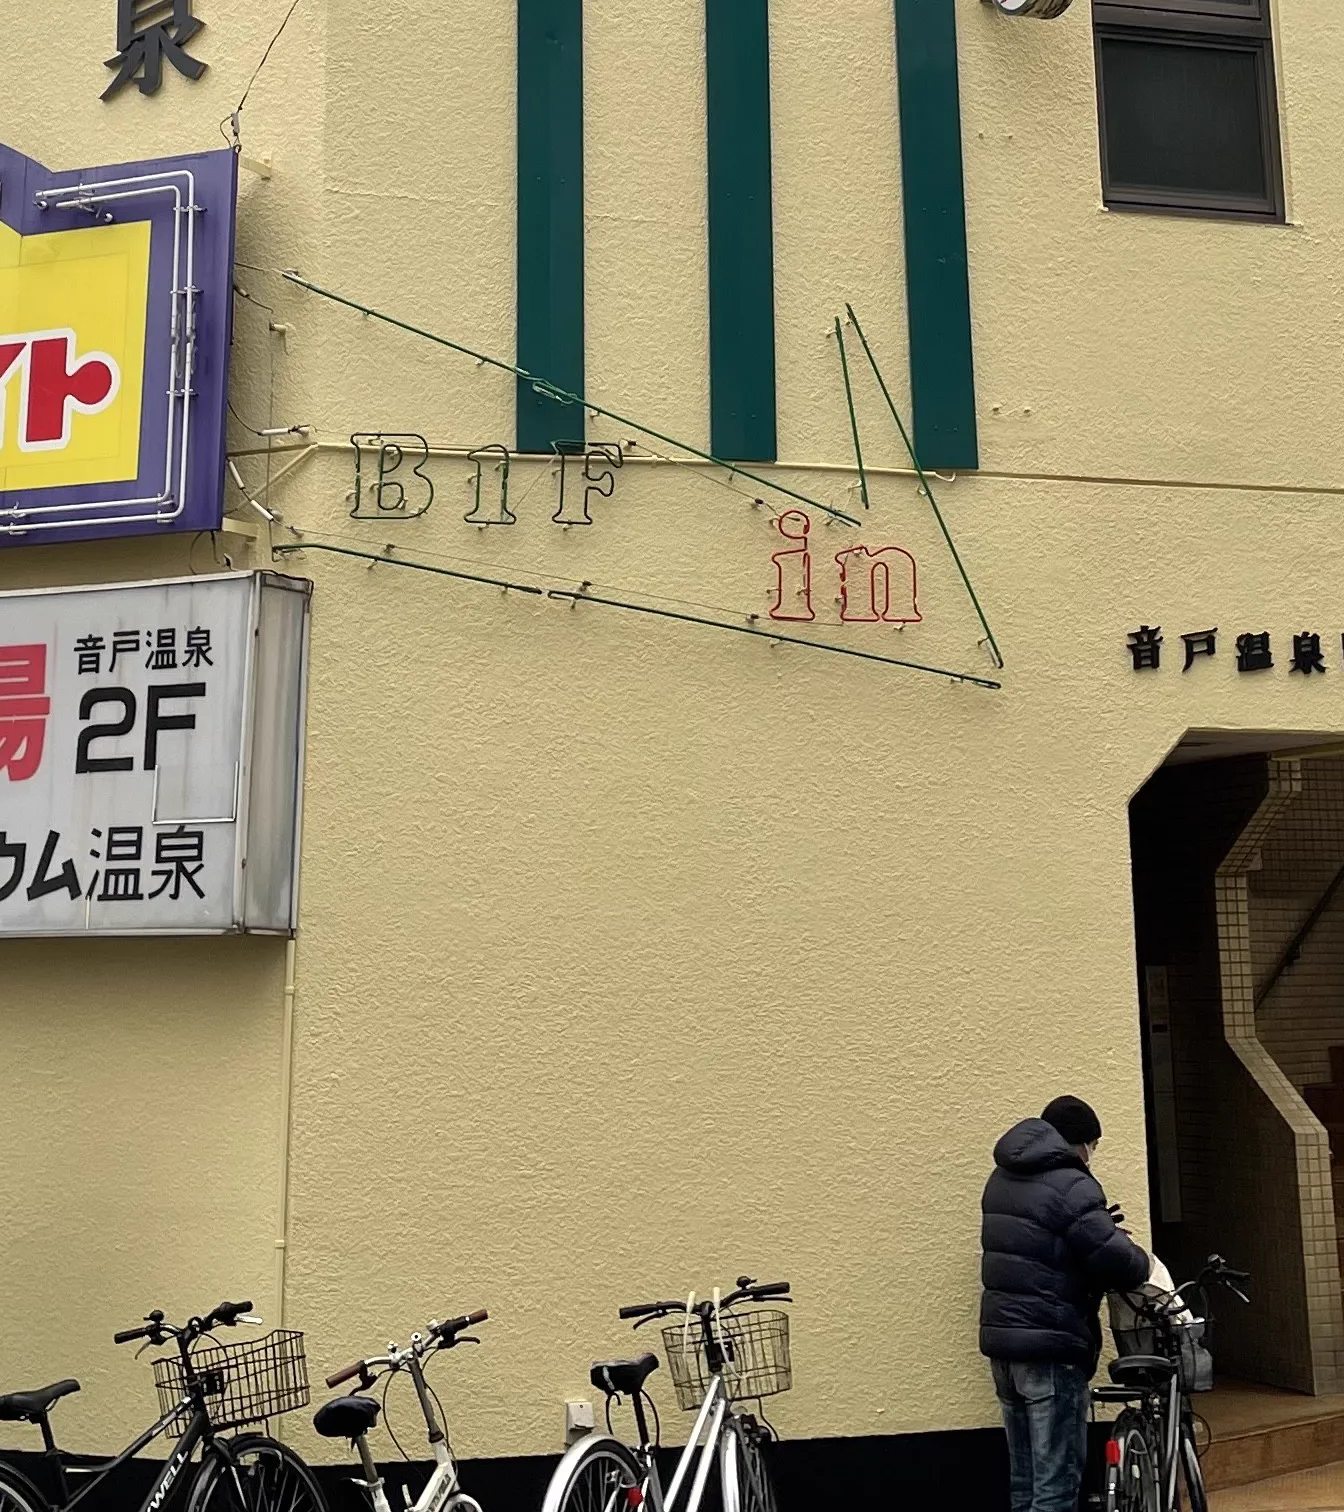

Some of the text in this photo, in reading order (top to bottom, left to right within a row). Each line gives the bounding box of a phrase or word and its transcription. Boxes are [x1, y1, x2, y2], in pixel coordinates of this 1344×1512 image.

[769, 510, 923, 623] in
[73, 625, 216, 677] 音戸温泉
[74, 681, 209, 775] 2F
